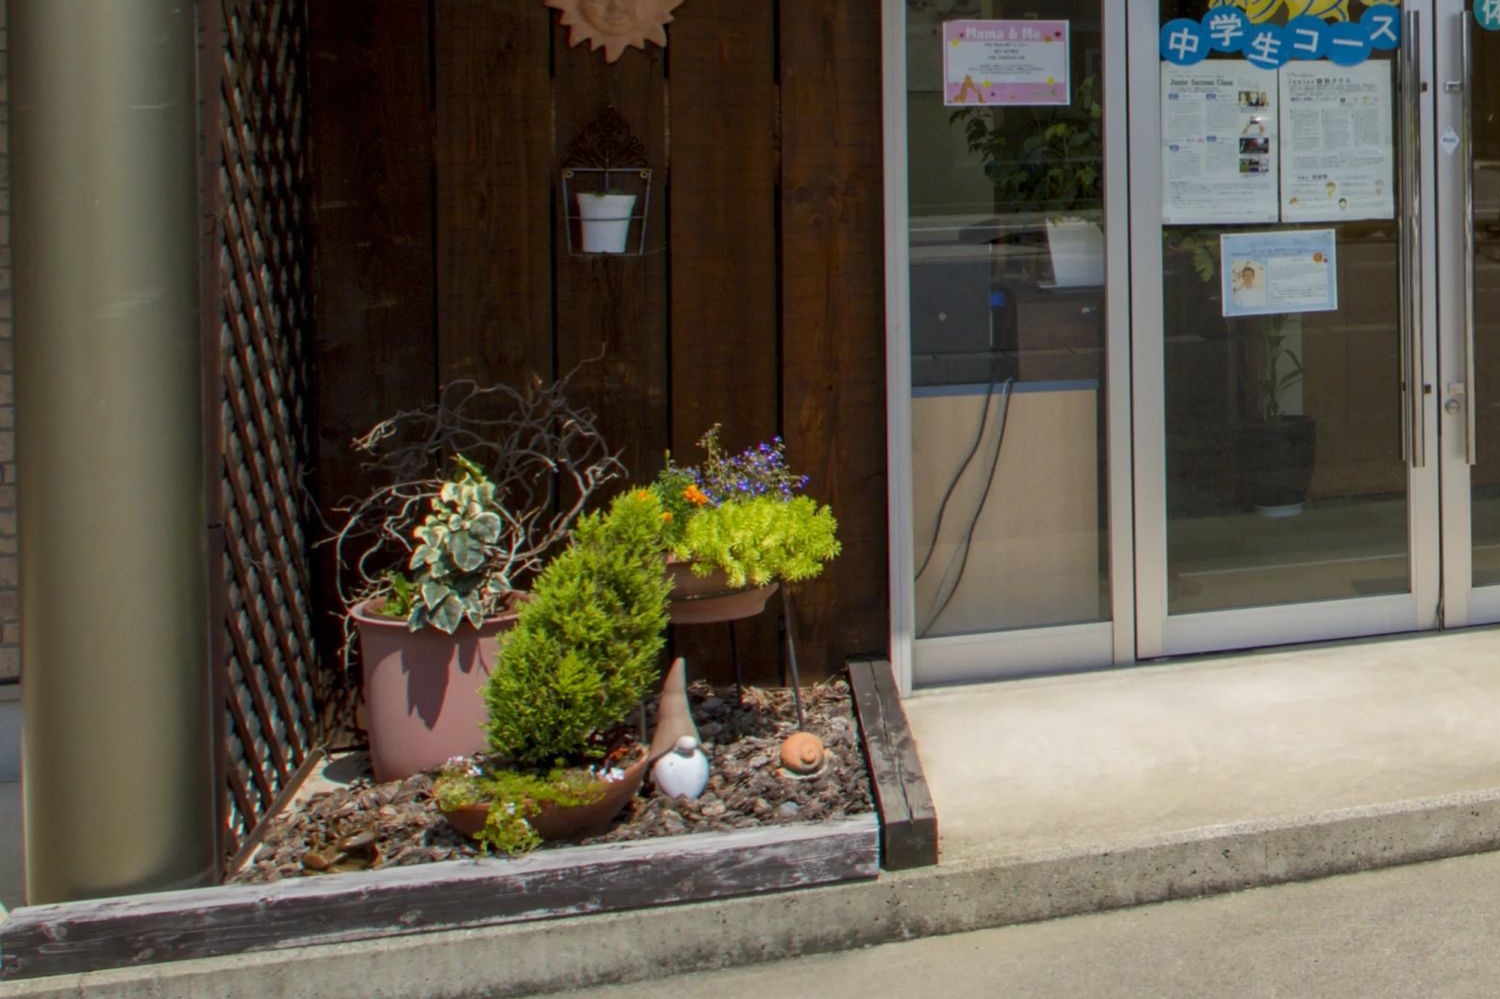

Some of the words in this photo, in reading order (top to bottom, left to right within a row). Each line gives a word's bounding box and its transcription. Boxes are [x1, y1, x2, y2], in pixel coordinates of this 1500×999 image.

[966, 26, 1004, 40] Mama
[1022, 26, 1041, 40] Me
[1168, 12, 1398, 65] 中学生コース
